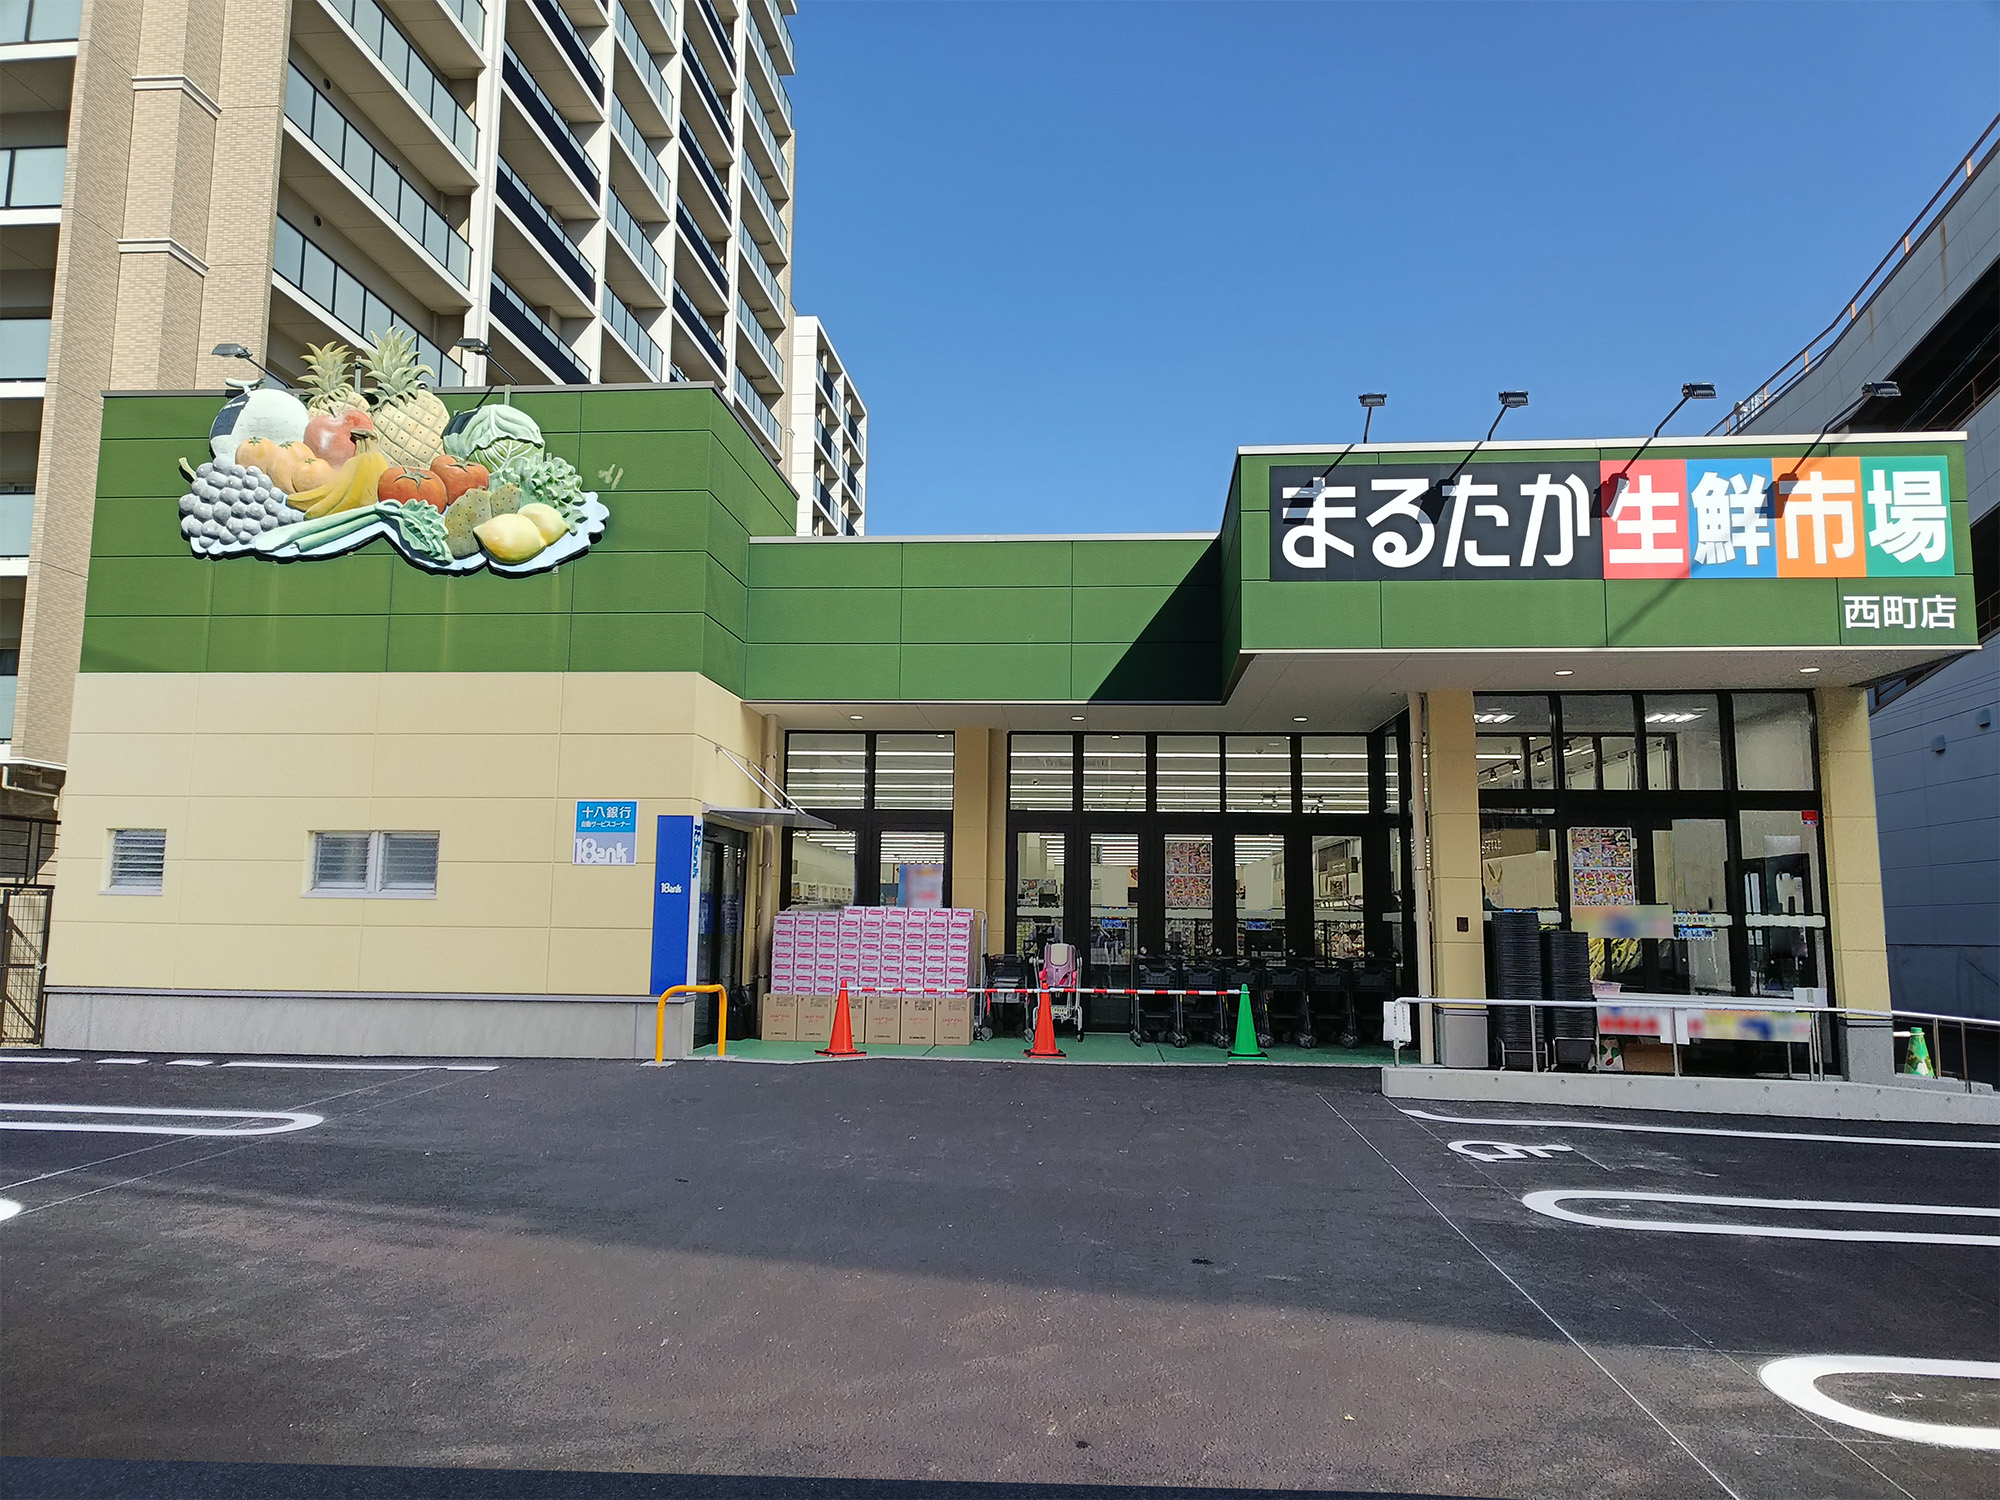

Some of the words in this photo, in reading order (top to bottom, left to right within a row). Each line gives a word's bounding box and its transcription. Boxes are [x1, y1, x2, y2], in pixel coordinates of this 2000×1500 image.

[1281, 469, 1948, 568] まるたか生鮮市場
[1843, 595, 1957, 629] 西町店
[581, 806, 632, 819] 十八銀行
